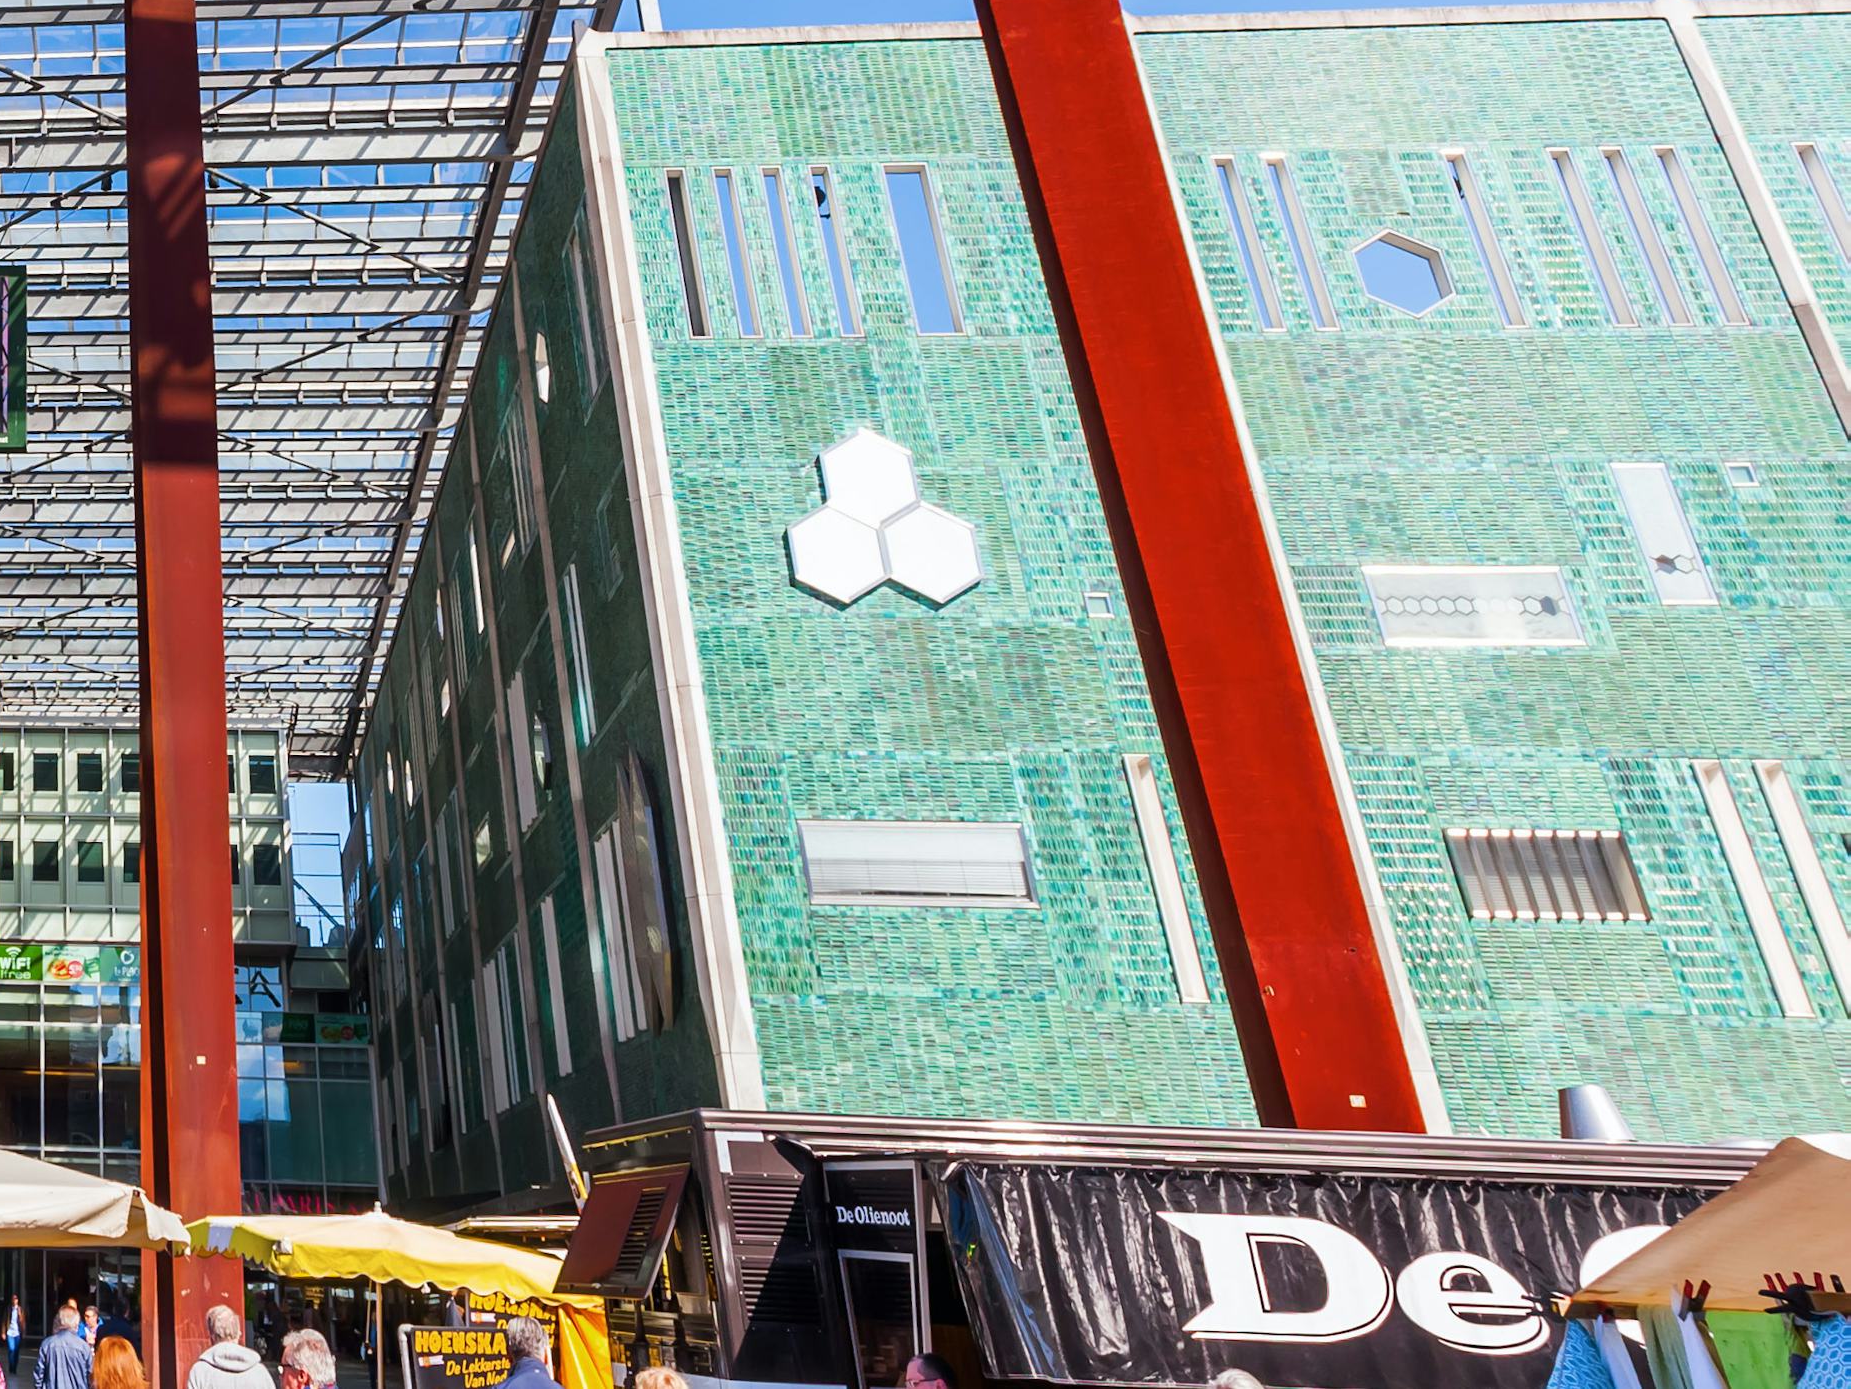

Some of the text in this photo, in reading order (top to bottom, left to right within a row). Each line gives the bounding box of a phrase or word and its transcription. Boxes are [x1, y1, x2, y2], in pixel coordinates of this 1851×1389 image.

[836, 1205, 910, 1226] De Olienoot
[1158, 1210, 1550, 1356] De
[445, 1359, 461, 1376] De
